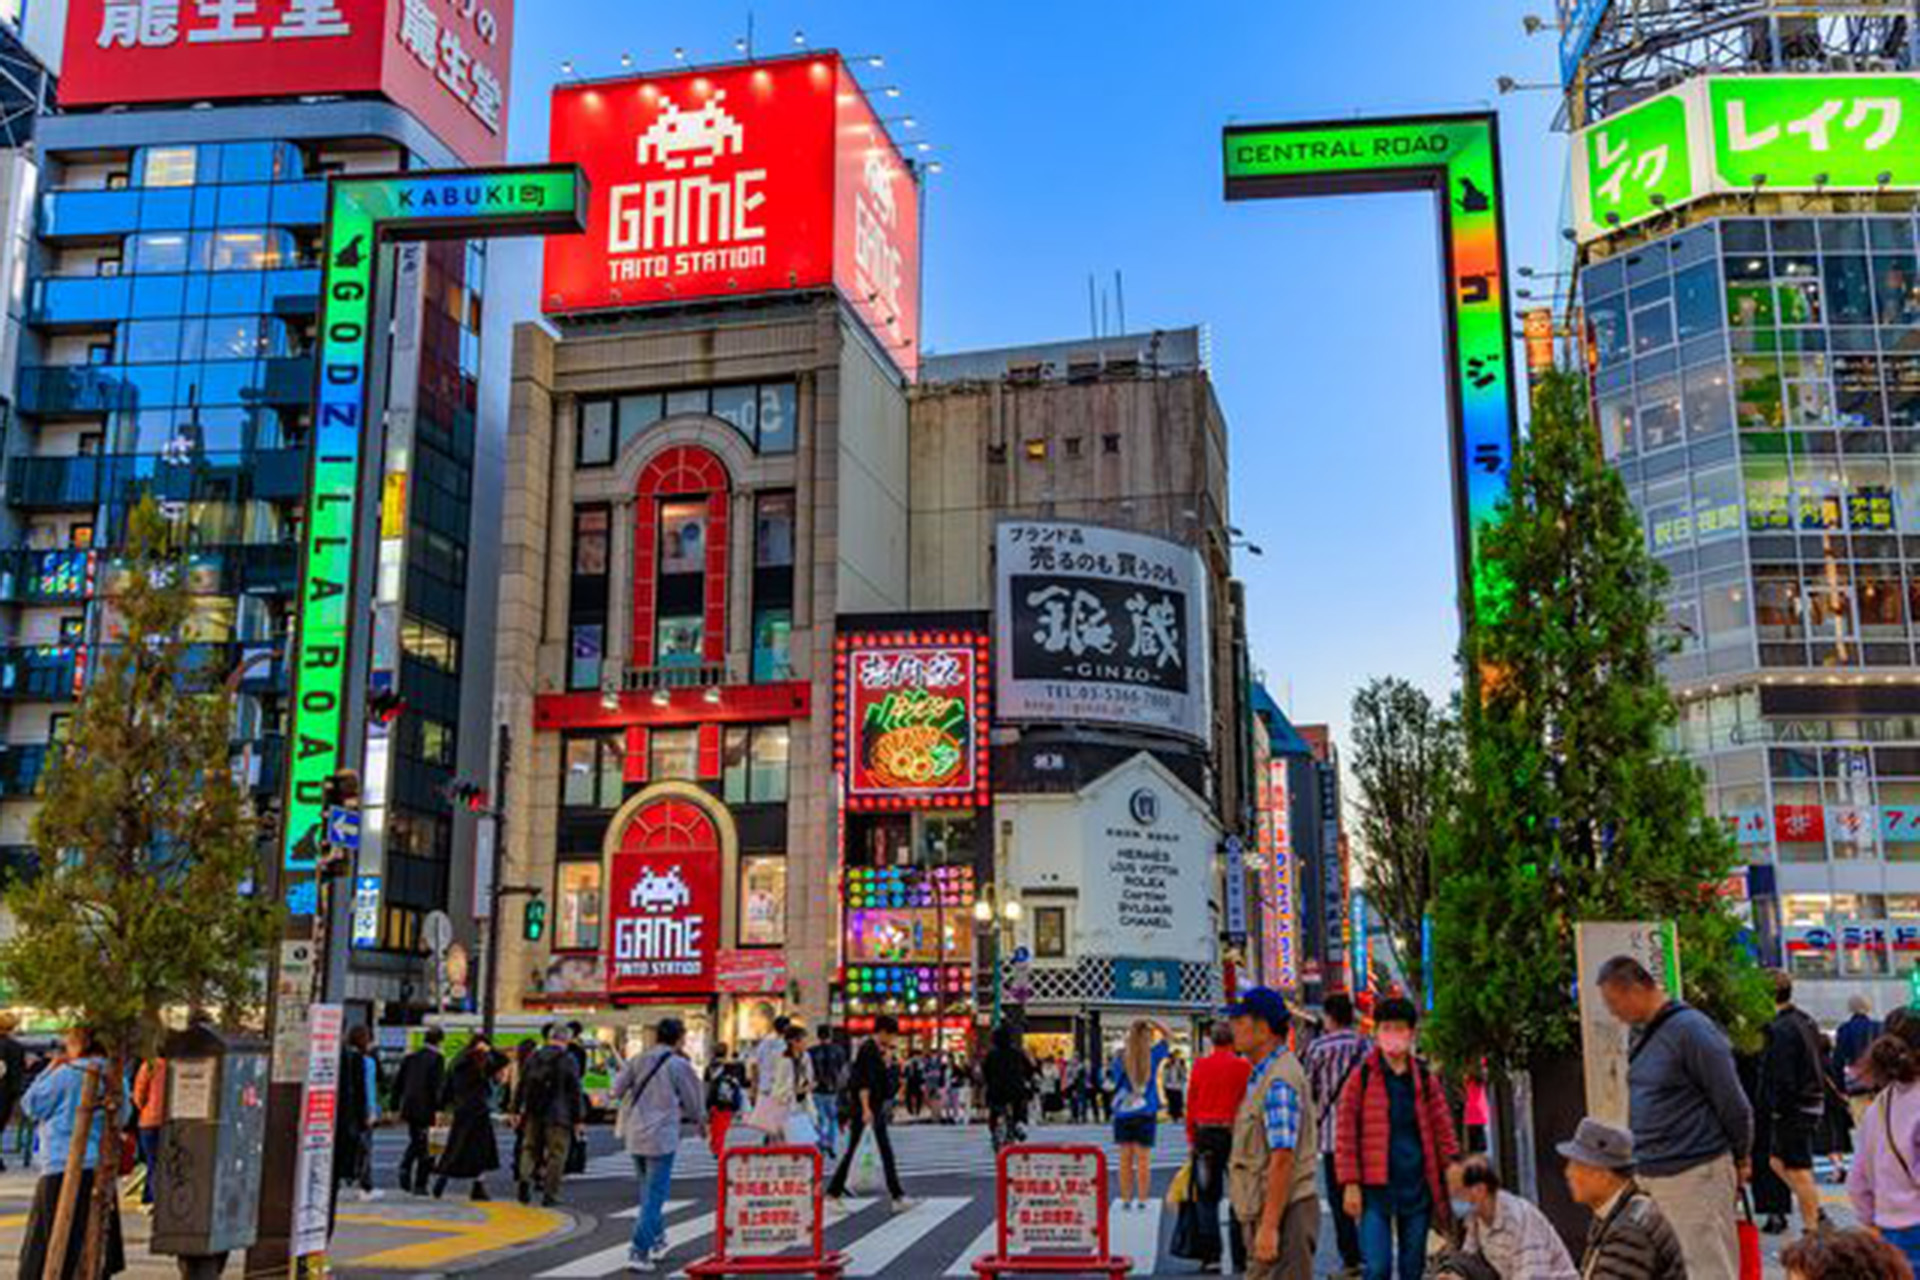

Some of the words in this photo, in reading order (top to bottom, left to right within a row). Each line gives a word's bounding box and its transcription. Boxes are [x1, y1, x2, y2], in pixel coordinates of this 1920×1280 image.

[1726, 97, 1901, 151] レイク
[1237, 139, 1364, 164] CENTRAL
[1373, 133, 1449, 157] ROAD
[608, 169, 767, 253] GAME
[608, 255, 669, 282] TAITO
[675, 245, 766, 275] STATION
[310, 281, 365, 602] GODZILLA
[1009, 527, 1084, 544] ブランド品
[615, 914, 703, 959] GAME
